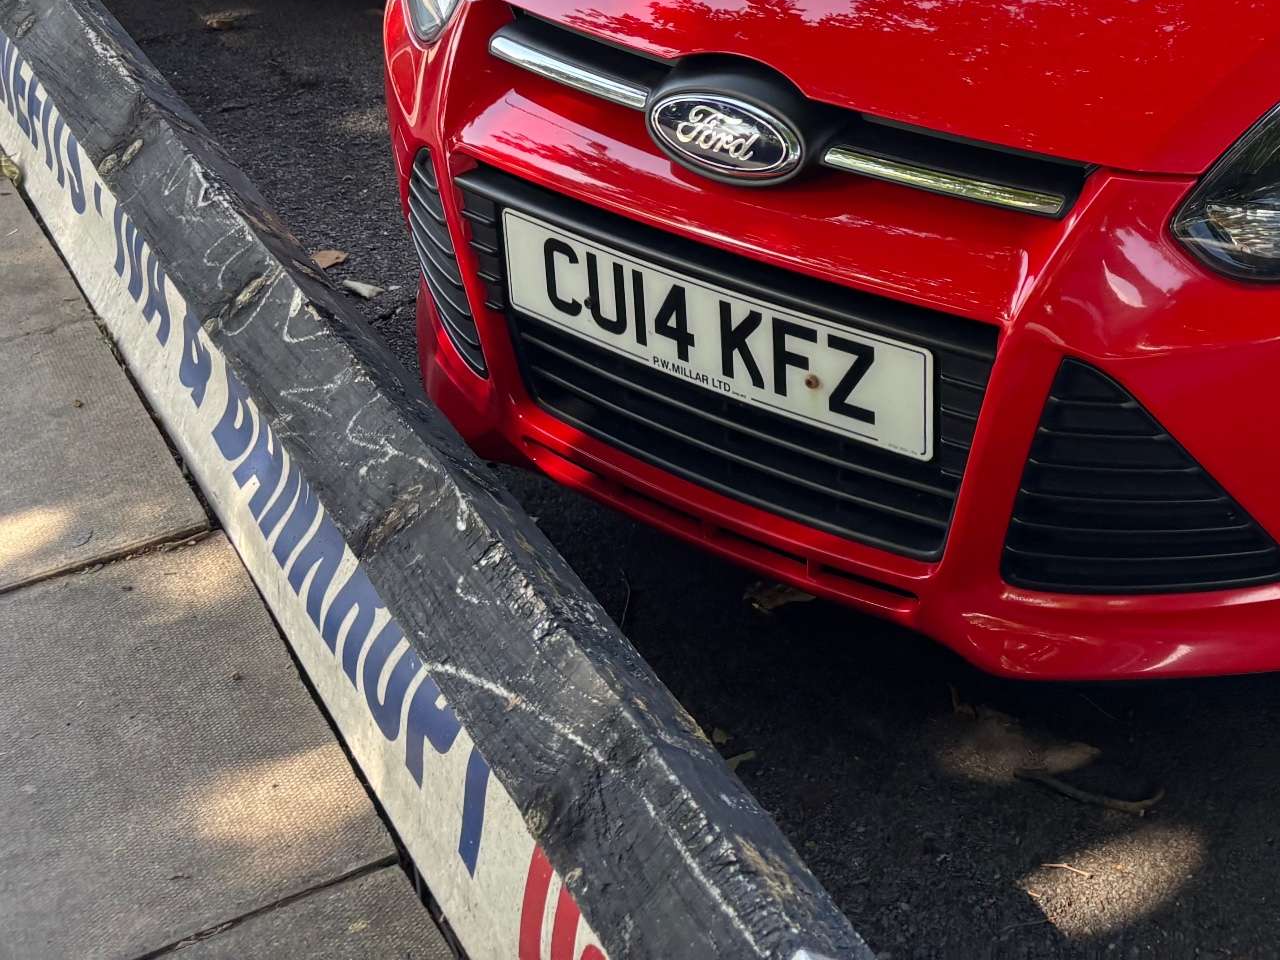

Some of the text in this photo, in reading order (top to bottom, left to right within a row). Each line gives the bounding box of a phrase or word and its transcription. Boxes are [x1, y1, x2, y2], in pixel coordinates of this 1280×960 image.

[675, 104, 763, 162] Ford
[179, 302, 213, 409] &
[542, 236, 877, 427] CU14 KFZ
[711, 377, 731, 393] LTD
